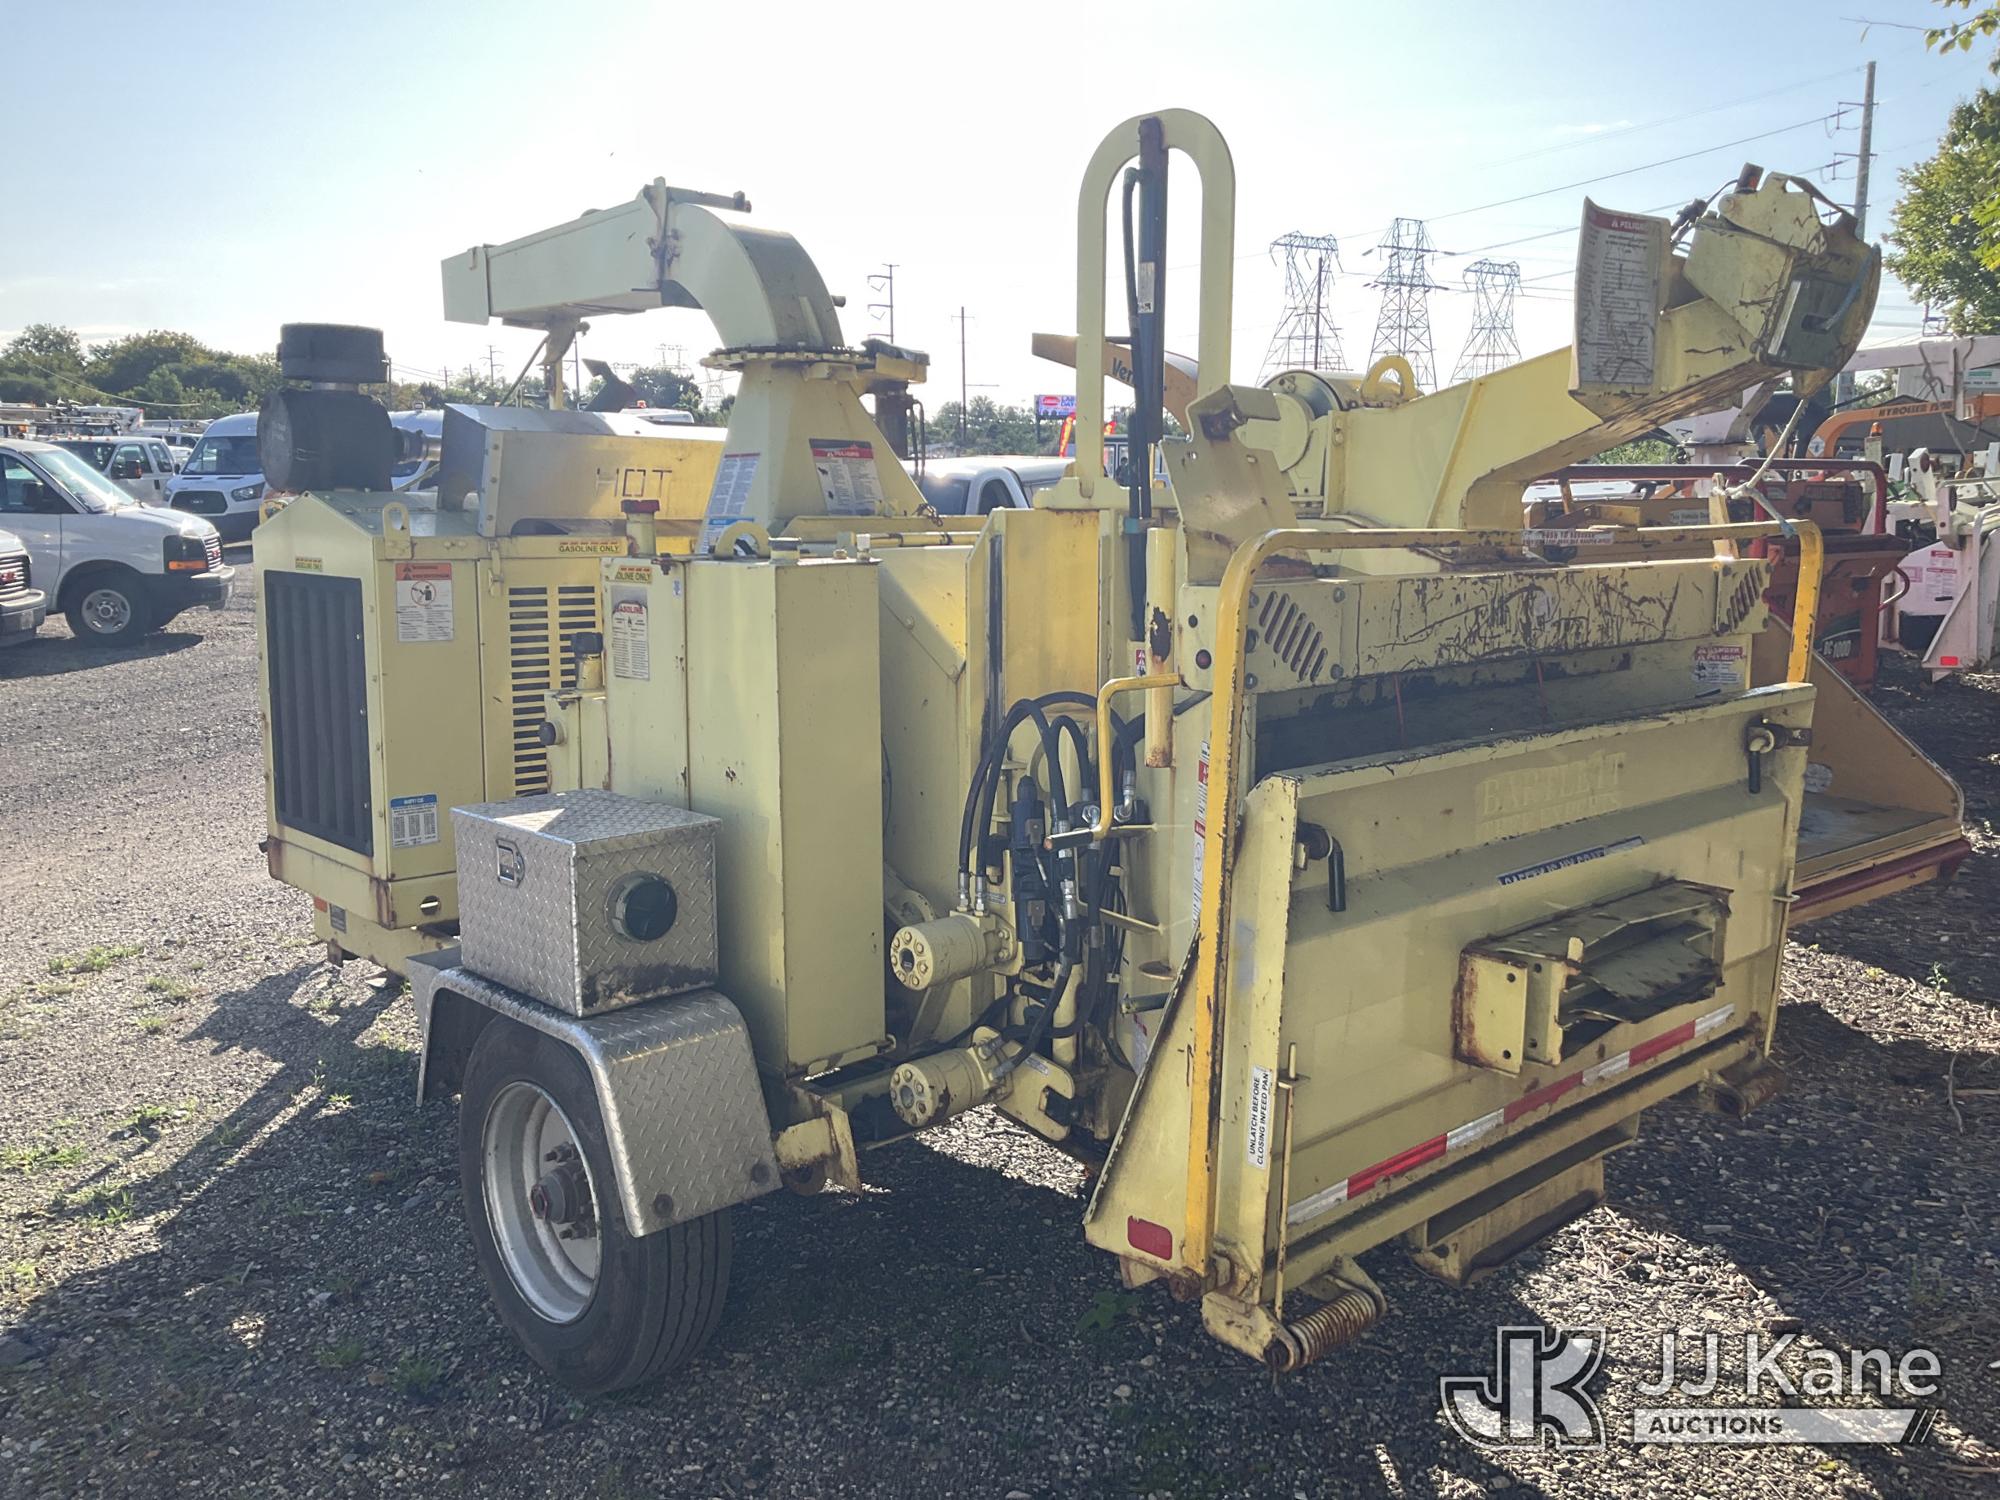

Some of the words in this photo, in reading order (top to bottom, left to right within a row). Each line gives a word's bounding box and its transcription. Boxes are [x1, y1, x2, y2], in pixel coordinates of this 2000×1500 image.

[1112, 357, 1134, 384] Ver
[594, 467, 672, 498] HOT
[559, 545, 598, 553] GASOLINE
[600, 545, 619, 553] ONLY
[1252, 1076, 1260, 1113] BEFORE
[1260, 1093, 1268, 1125] INFEED
[1249, 1114, 1258, 1155] UNLATCH
[1257, 1126, 1266, 1165] CLOSING
